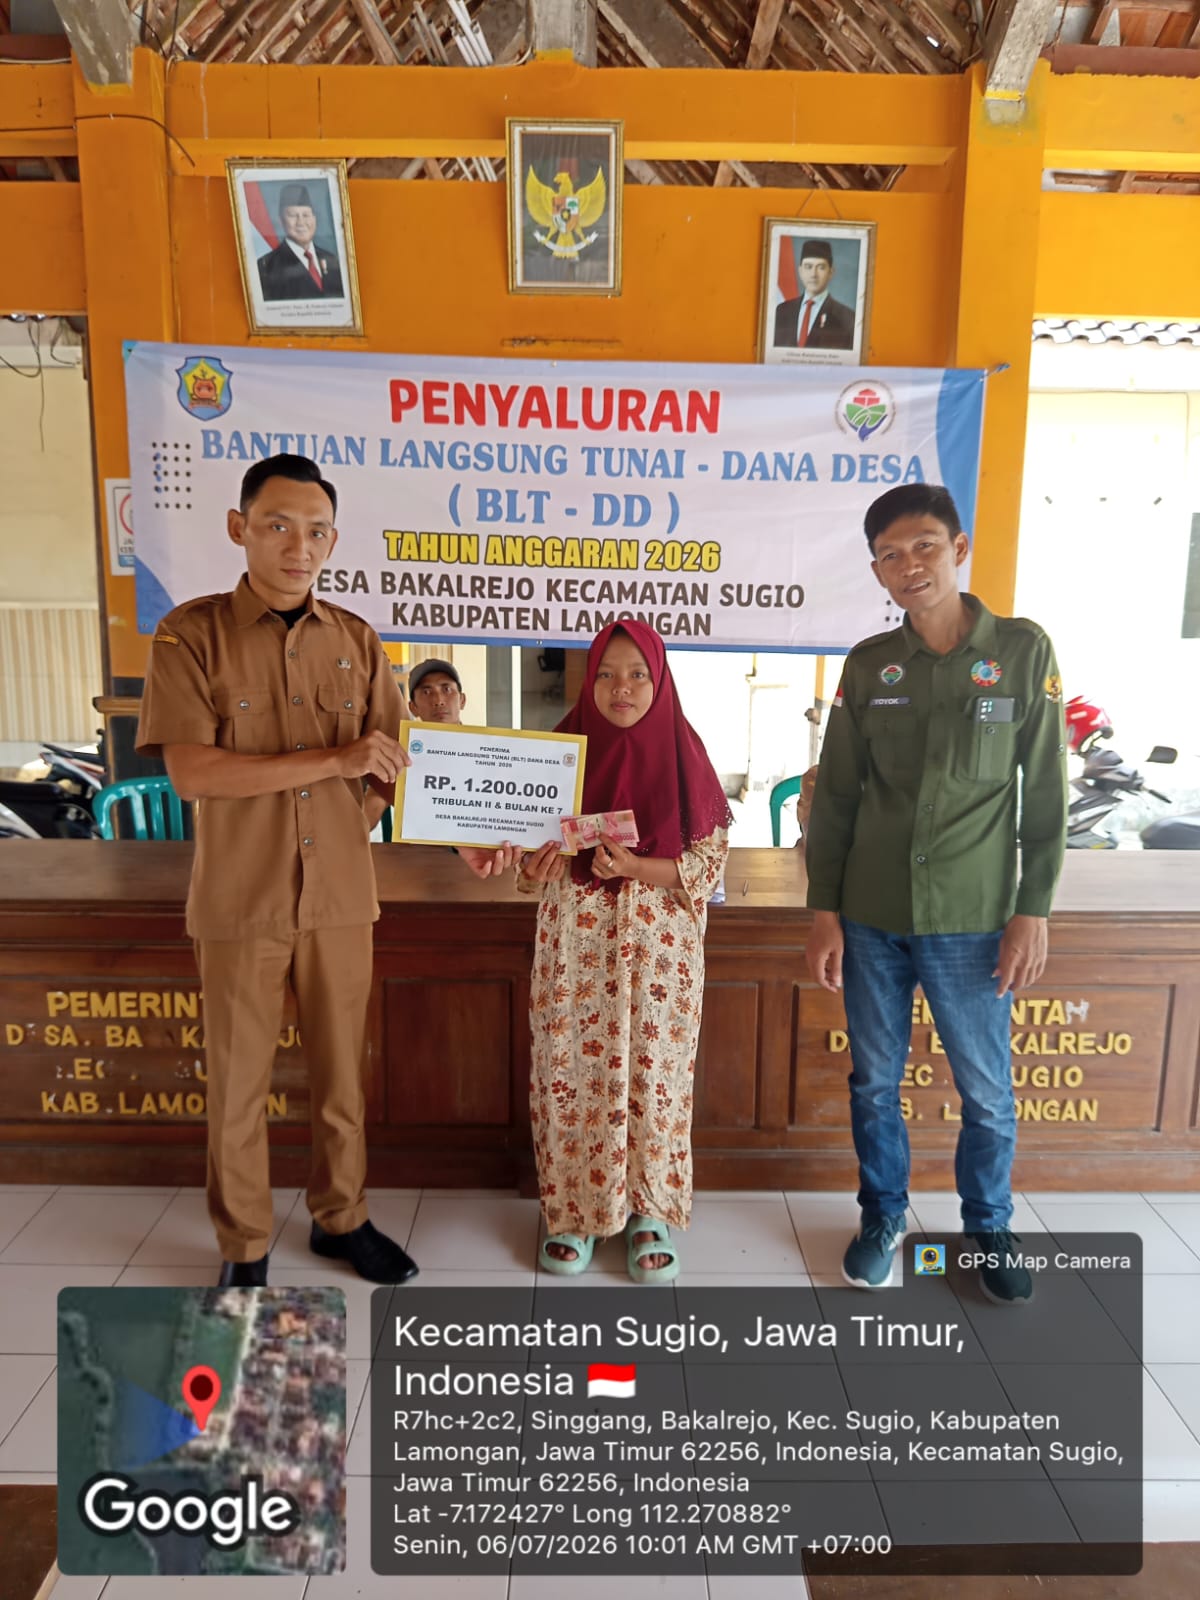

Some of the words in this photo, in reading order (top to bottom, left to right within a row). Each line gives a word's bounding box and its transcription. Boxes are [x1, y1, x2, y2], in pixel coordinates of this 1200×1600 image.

[389, 379, 721, 434] PENYALURAN
[201, 429, 366, 466] BANTUAN
[380, 438, 568, 476] LANGSUNG
[581, 446, 686, 480] TUNAI
[721, 450, 818, 482] DANA
[831, 453, 925, 484] DESA
[476, 488, 551, 525] BLT
[592, 493, 652, 528] DD
[383, 530, 479, 565] TAHUN
[485, 532, 639, 570] ANGGARAN
[644, 540, 722, 573] 2026
[317, 568, 370, 594] ESA
[381, 571, 535, 601] BAKALREJO
[546, 578, 709, 607] KECAMATAN
[719, 583, 805, 609] SUGIO
[392, 602, 550, 631] KABUPATEN
[427, 749, 457, 757] BANTUAN
[480, 746, 511, 754] PENERIMA
[423, 775, 457, 792] RP.
[463, 778, 559, 800] 1.200.000
[431, 797, 482, 809] TRIBULAN
[494, 802, 502, 810] &
[505, 802, 538, 813] BULAN
[541, 805, 555, 814] KE
[556, 807, 563, 815] 7
[457, 822, 493, 830] KABUPATEN
[489, 818, 525, 826] KECAMATAN
[47, 991, 204, 1018] PEMERIN
[1011, 1064, 1083, 1087] UGIO
